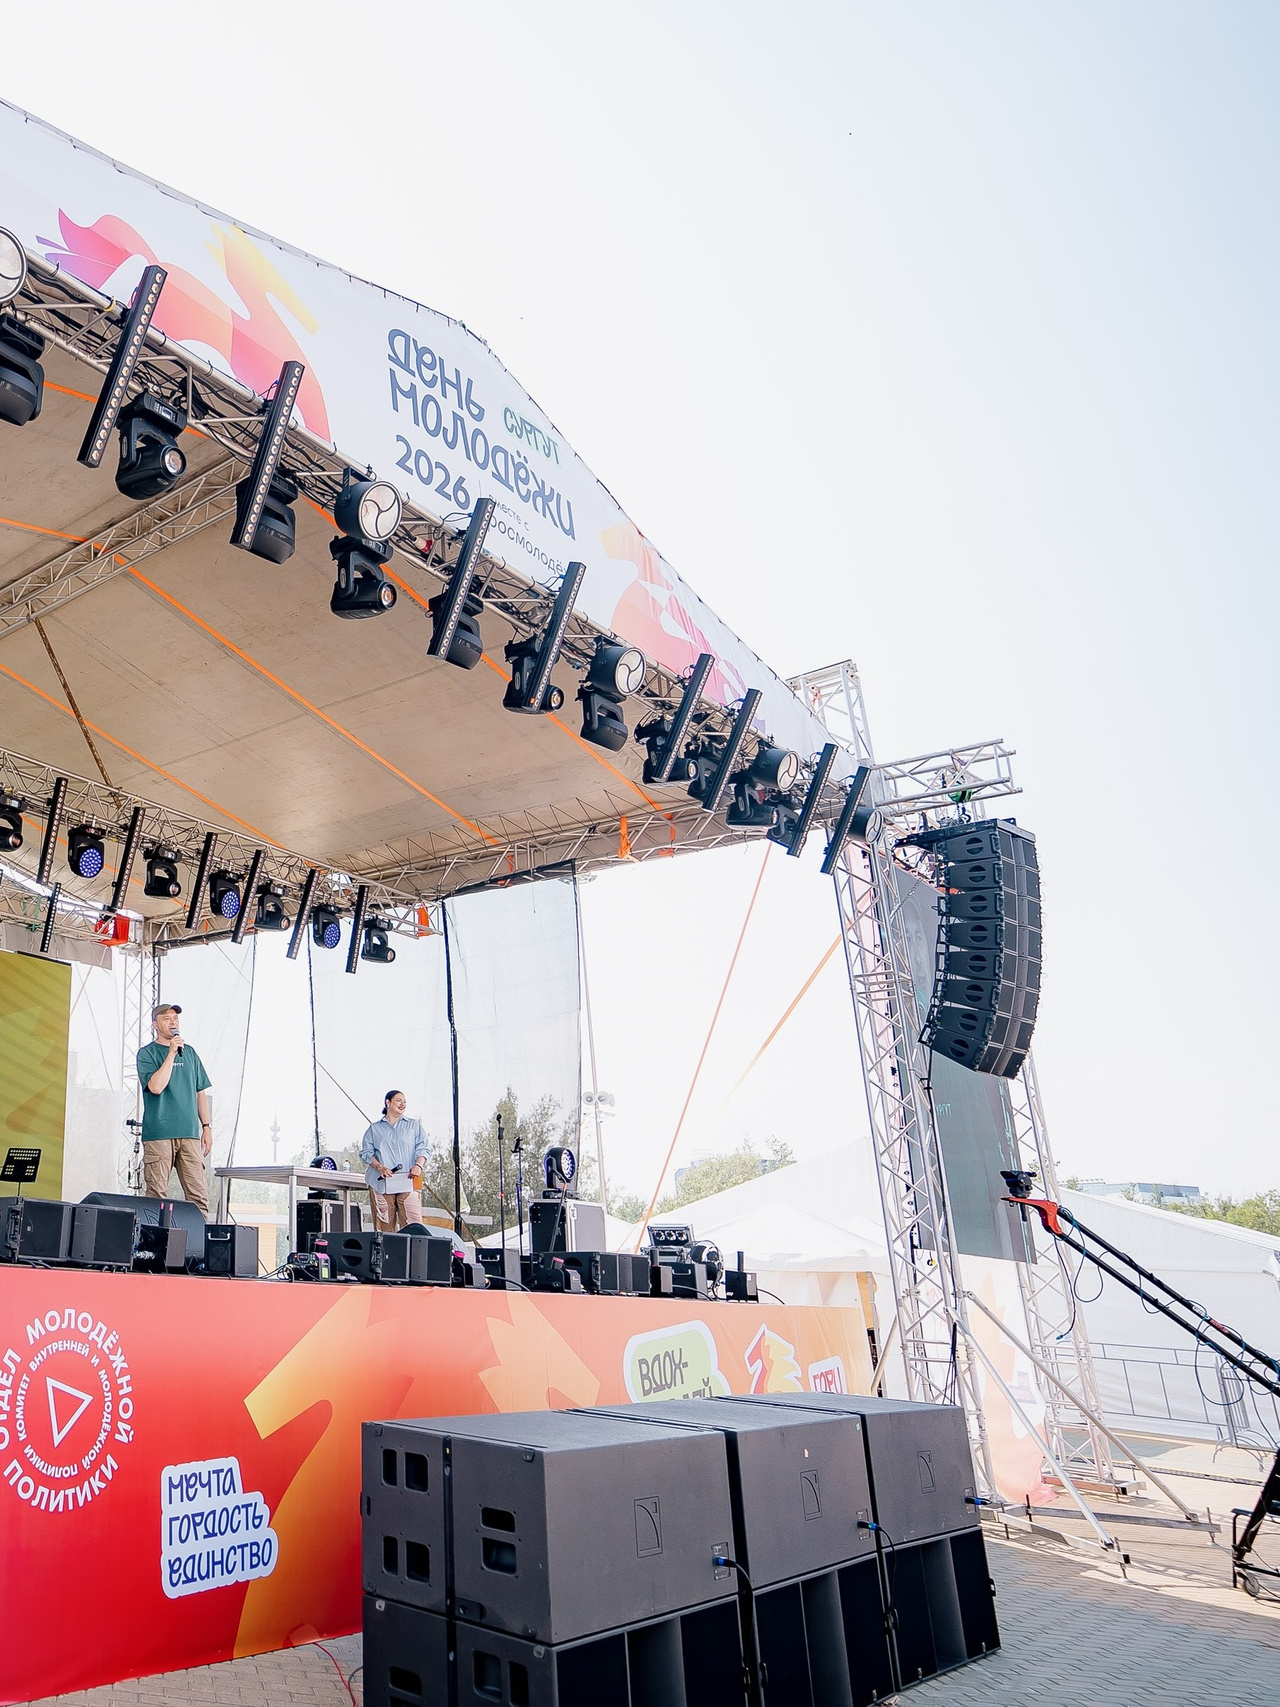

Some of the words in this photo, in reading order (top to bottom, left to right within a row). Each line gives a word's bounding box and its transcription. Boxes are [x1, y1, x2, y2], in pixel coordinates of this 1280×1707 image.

[503, 406, 560, 465] СУРГУТ
[395, 434, 471, 510] 2026
[25, 1308, 134, 1444] МОЛОДЁЖНОЙ
[28, 1339, 90, 1372] ВНУТРЕННЕЙ
[90, 1354, 101, 1367] И
[638, 1348, 689, 1397] ВДОХ-
[15, 1373, 31, 1441] КОМИТЕТ
[3, 1453, 119, 1513] ПОЛИТИКИ
[23, 1444, 79, 1478] ПОЛИТИКИ
[169, 1502, 264, 1546] ГОРДОСТЬ
